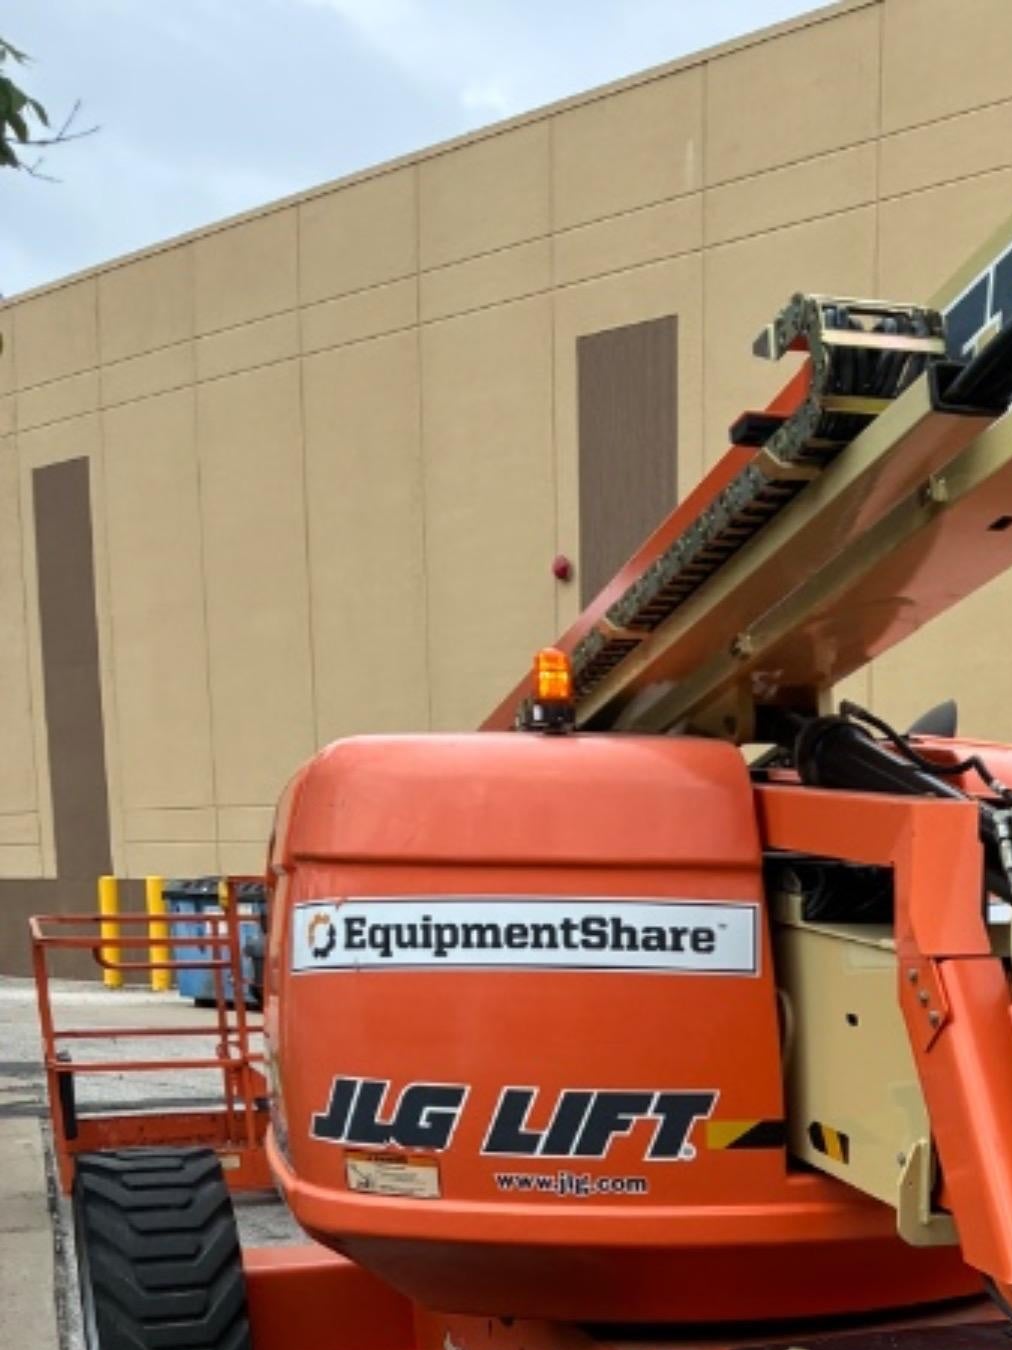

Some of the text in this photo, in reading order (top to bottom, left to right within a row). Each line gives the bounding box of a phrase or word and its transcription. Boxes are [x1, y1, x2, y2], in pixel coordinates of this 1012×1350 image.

[344, 916, 716, 956] EquipmentShare
[311, 1077, 469, 1150] JLG
[495, 1171, 649, 1195] www.jlg.com
